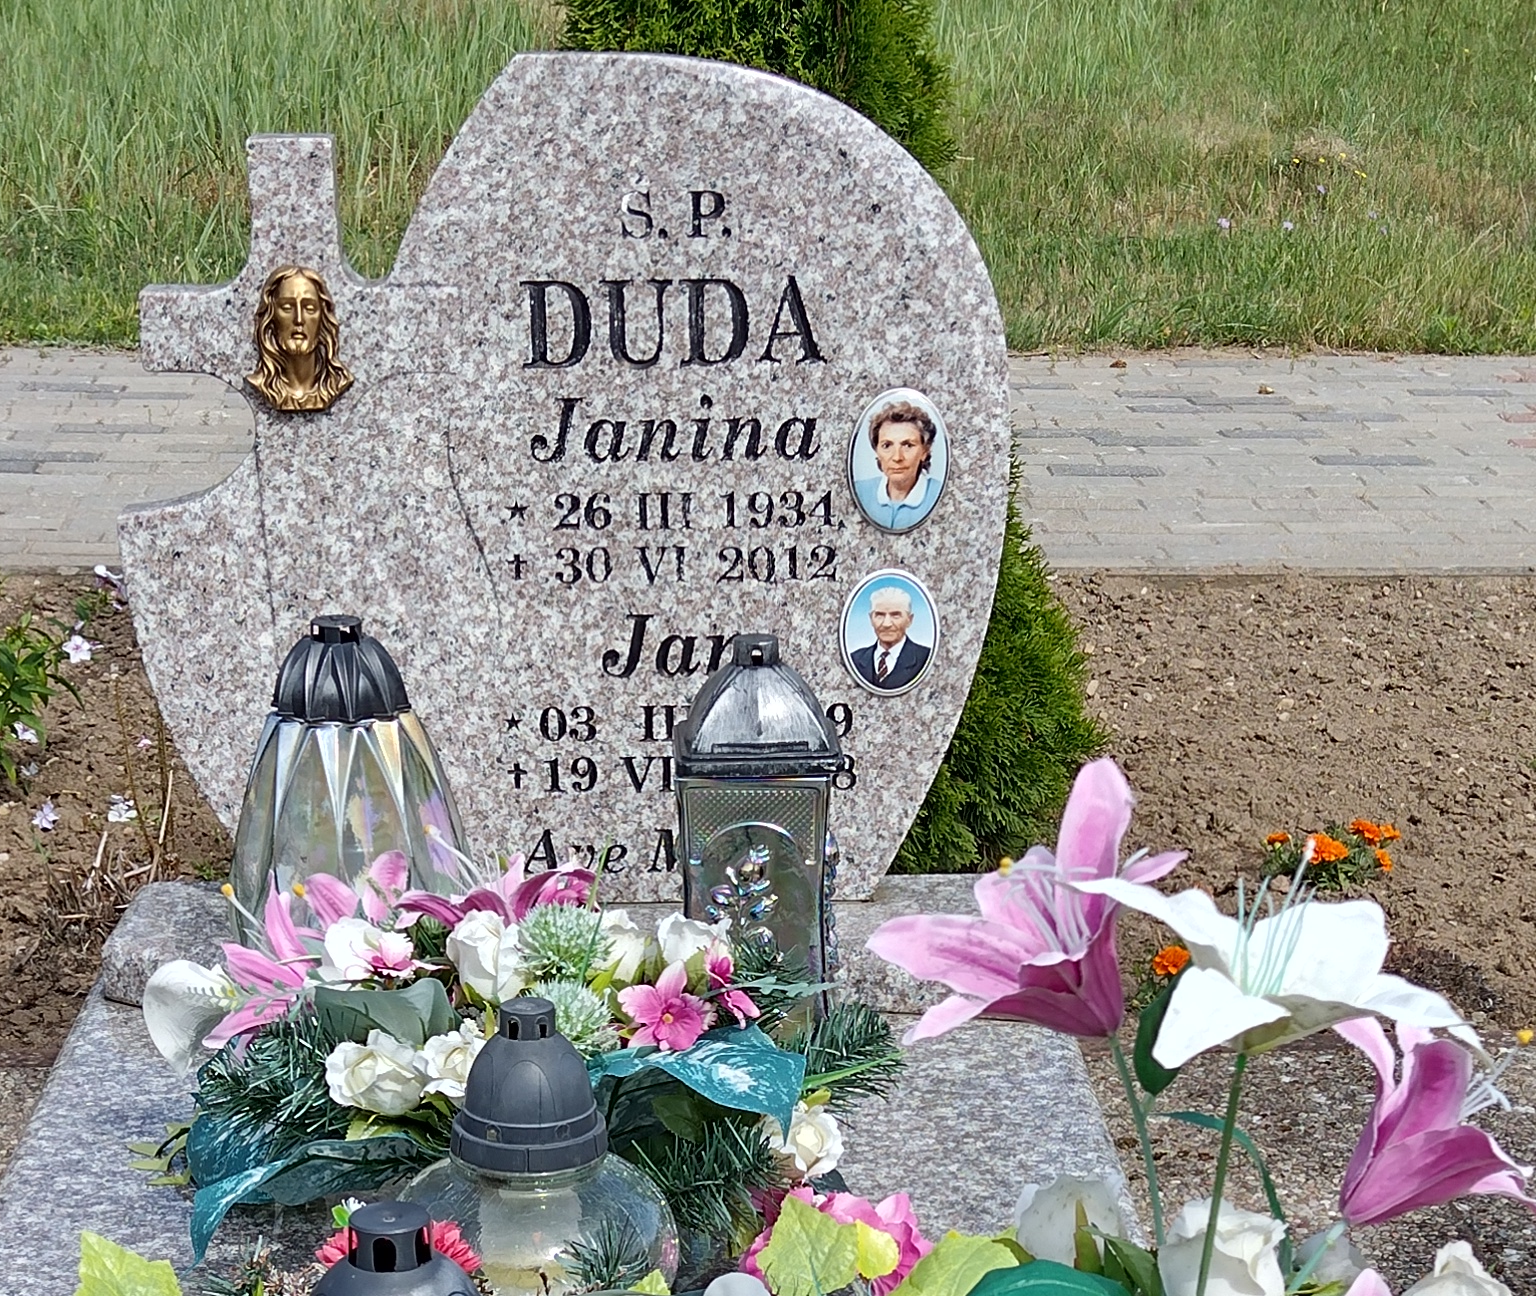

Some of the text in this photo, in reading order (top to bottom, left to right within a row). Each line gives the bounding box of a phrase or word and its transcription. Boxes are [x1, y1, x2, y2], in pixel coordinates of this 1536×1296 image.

[685, 189, 732, 239] P.
[519, 275, 828, 370] DUDA
[530, 393, 821, 464] Janina
[553, 492, 613, 531] 26
[634, 491, 697, 531] III
[555, 545, 837, 586] 30 VI 2012
[539, 704, 692, 742] 03 II
[543, 757, 598, 793] 19
